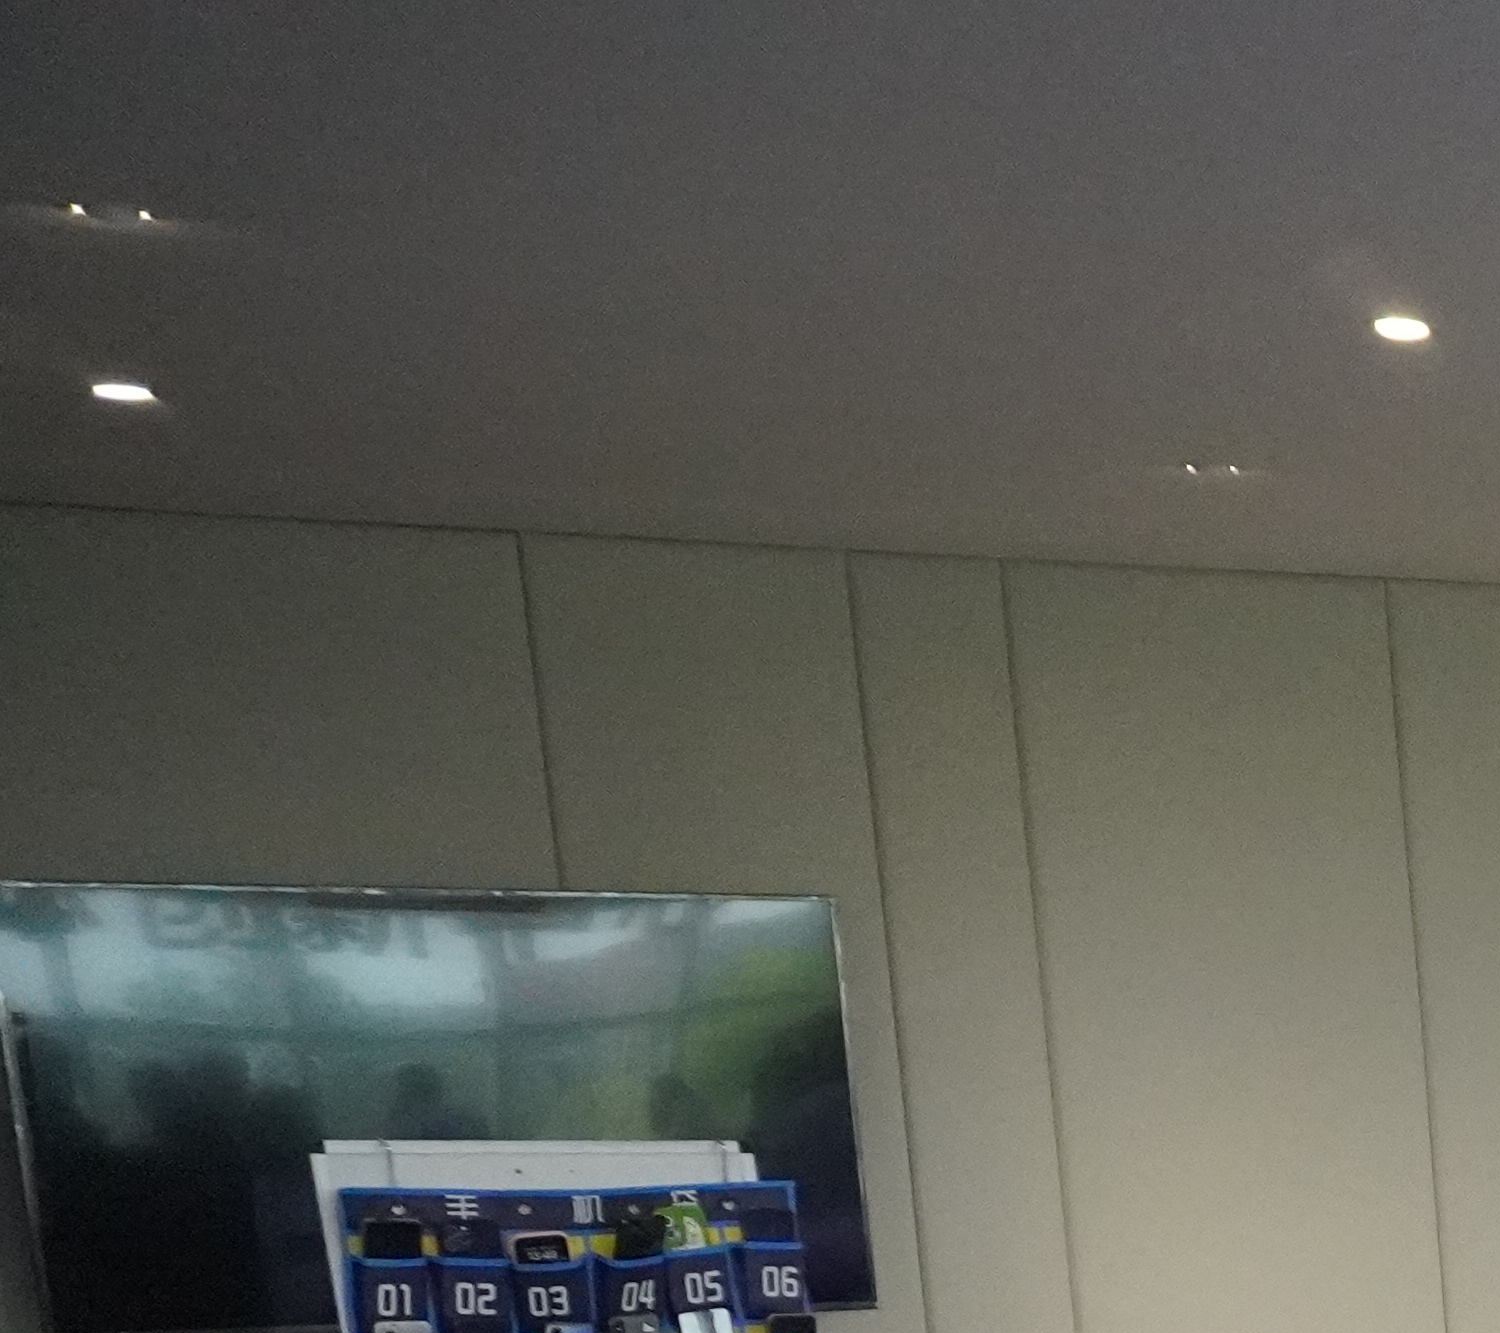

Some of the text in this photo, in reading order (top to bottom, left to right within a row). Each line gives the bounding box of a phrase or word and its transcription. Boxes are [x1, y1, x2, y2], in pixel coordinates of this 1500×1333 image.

[378, 1266, 799, 1316] 01 02 03 04 05 06
